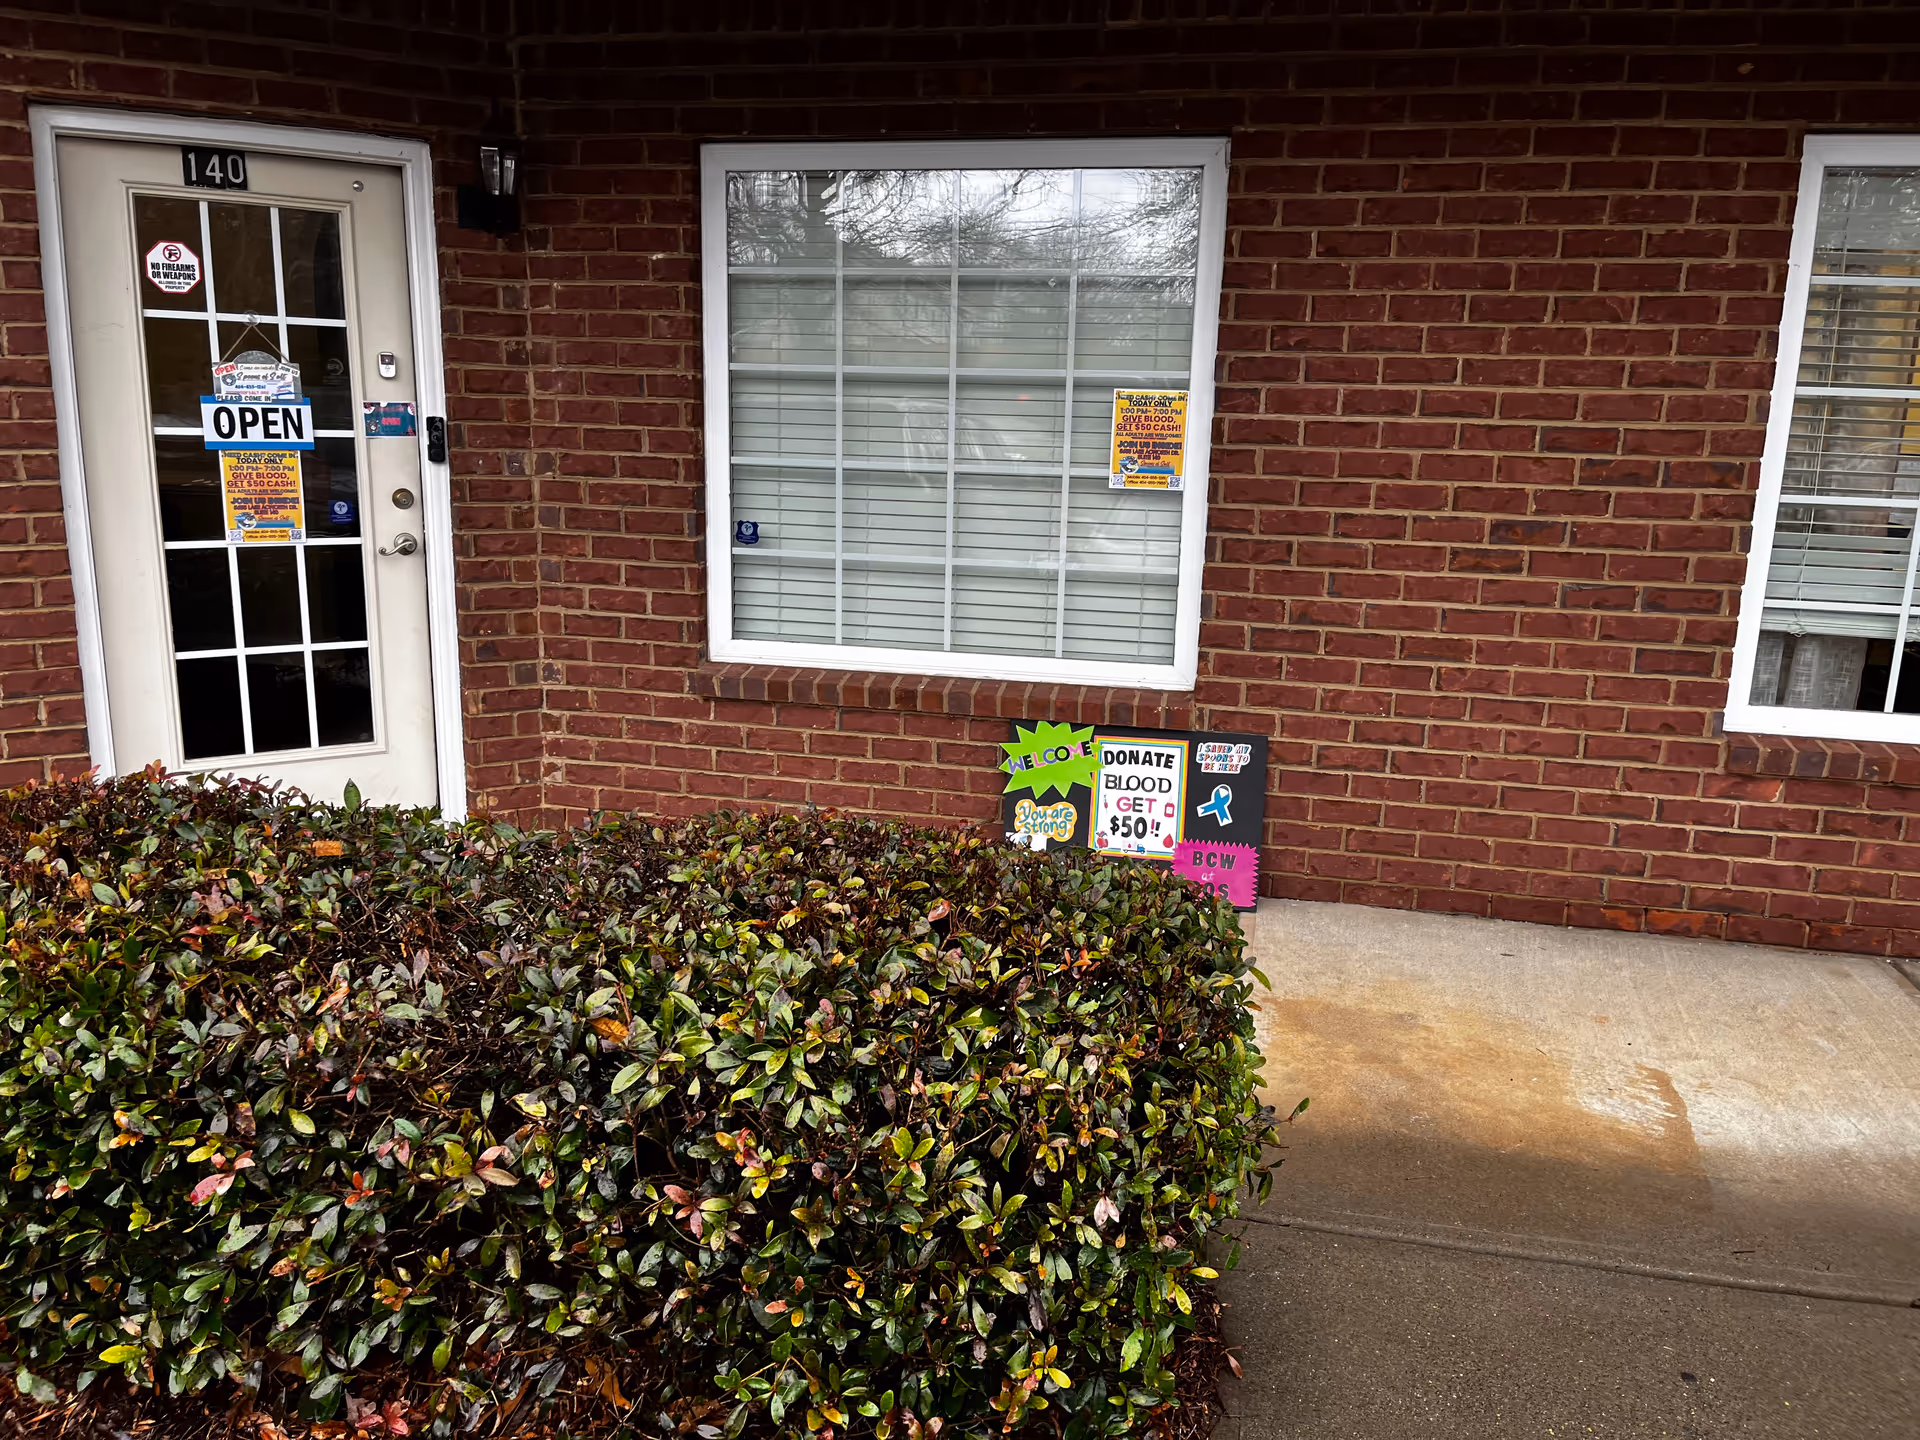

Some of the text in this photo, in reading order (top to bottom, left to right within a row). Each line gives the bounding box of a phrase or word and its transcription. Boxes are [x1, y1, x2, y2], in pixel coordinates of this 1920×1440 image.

[188, 152, 244, 184] 140
[151, 262, 196, 272] NO FIREARMS
[152, 270, 196, 281] OR WEAPONS
[214, 364, 236, 376] OPEN
[262, 373, 268, 381] of
[213, 406, 304, 440] OPEN
[1144, 416, 1176, 424] BLOOD,
[1153, 424, 1181, 432] CASH!
[256, 472, 290, 480] BLOOD,
[1205, 744, 1233, 753] SAVED
[1236, 745, 1250, 754] MY
[1008, 740, 1093, 774] WELCOME
[1104, 750, 1175, 769] DONATE
[1198, 753, 1249, 763] SPOONS TO
[1204, 762, 1239, 772] BE HERE
[1104, 774, 1172, 793] BLOOD
[1116, 796, 1157, 813] GET
[1019, 805, 1073, 823] You are
[1024, 820, 1067, 837] strong
[1192, 850, 1236, 870] BCW
[1202, 872, 1216, 880] at
[1193, 881, 1229, 901] OS
